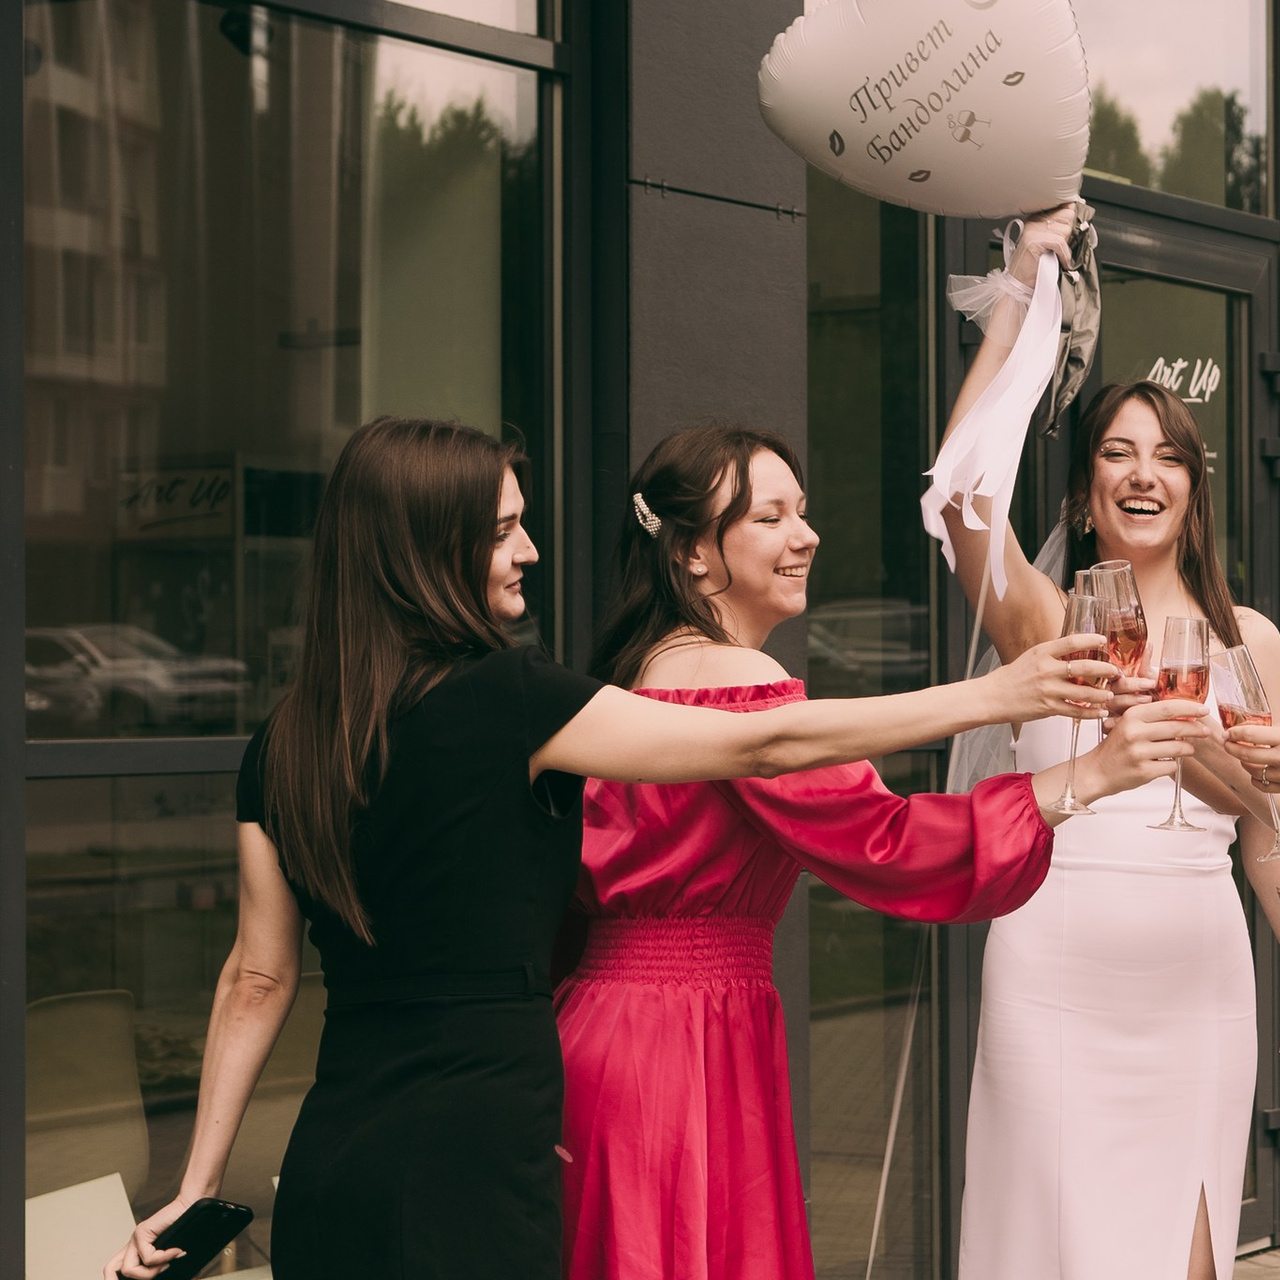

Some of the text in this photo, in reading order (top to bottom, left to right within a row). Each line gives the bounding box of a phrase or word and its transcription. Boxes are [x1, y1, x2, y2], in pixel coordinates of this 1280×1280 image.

[849, 19, 955, 124] Привет
[866, 28, 1004, 166] Бандолина
[1189, 357, 1221, 403] Up
